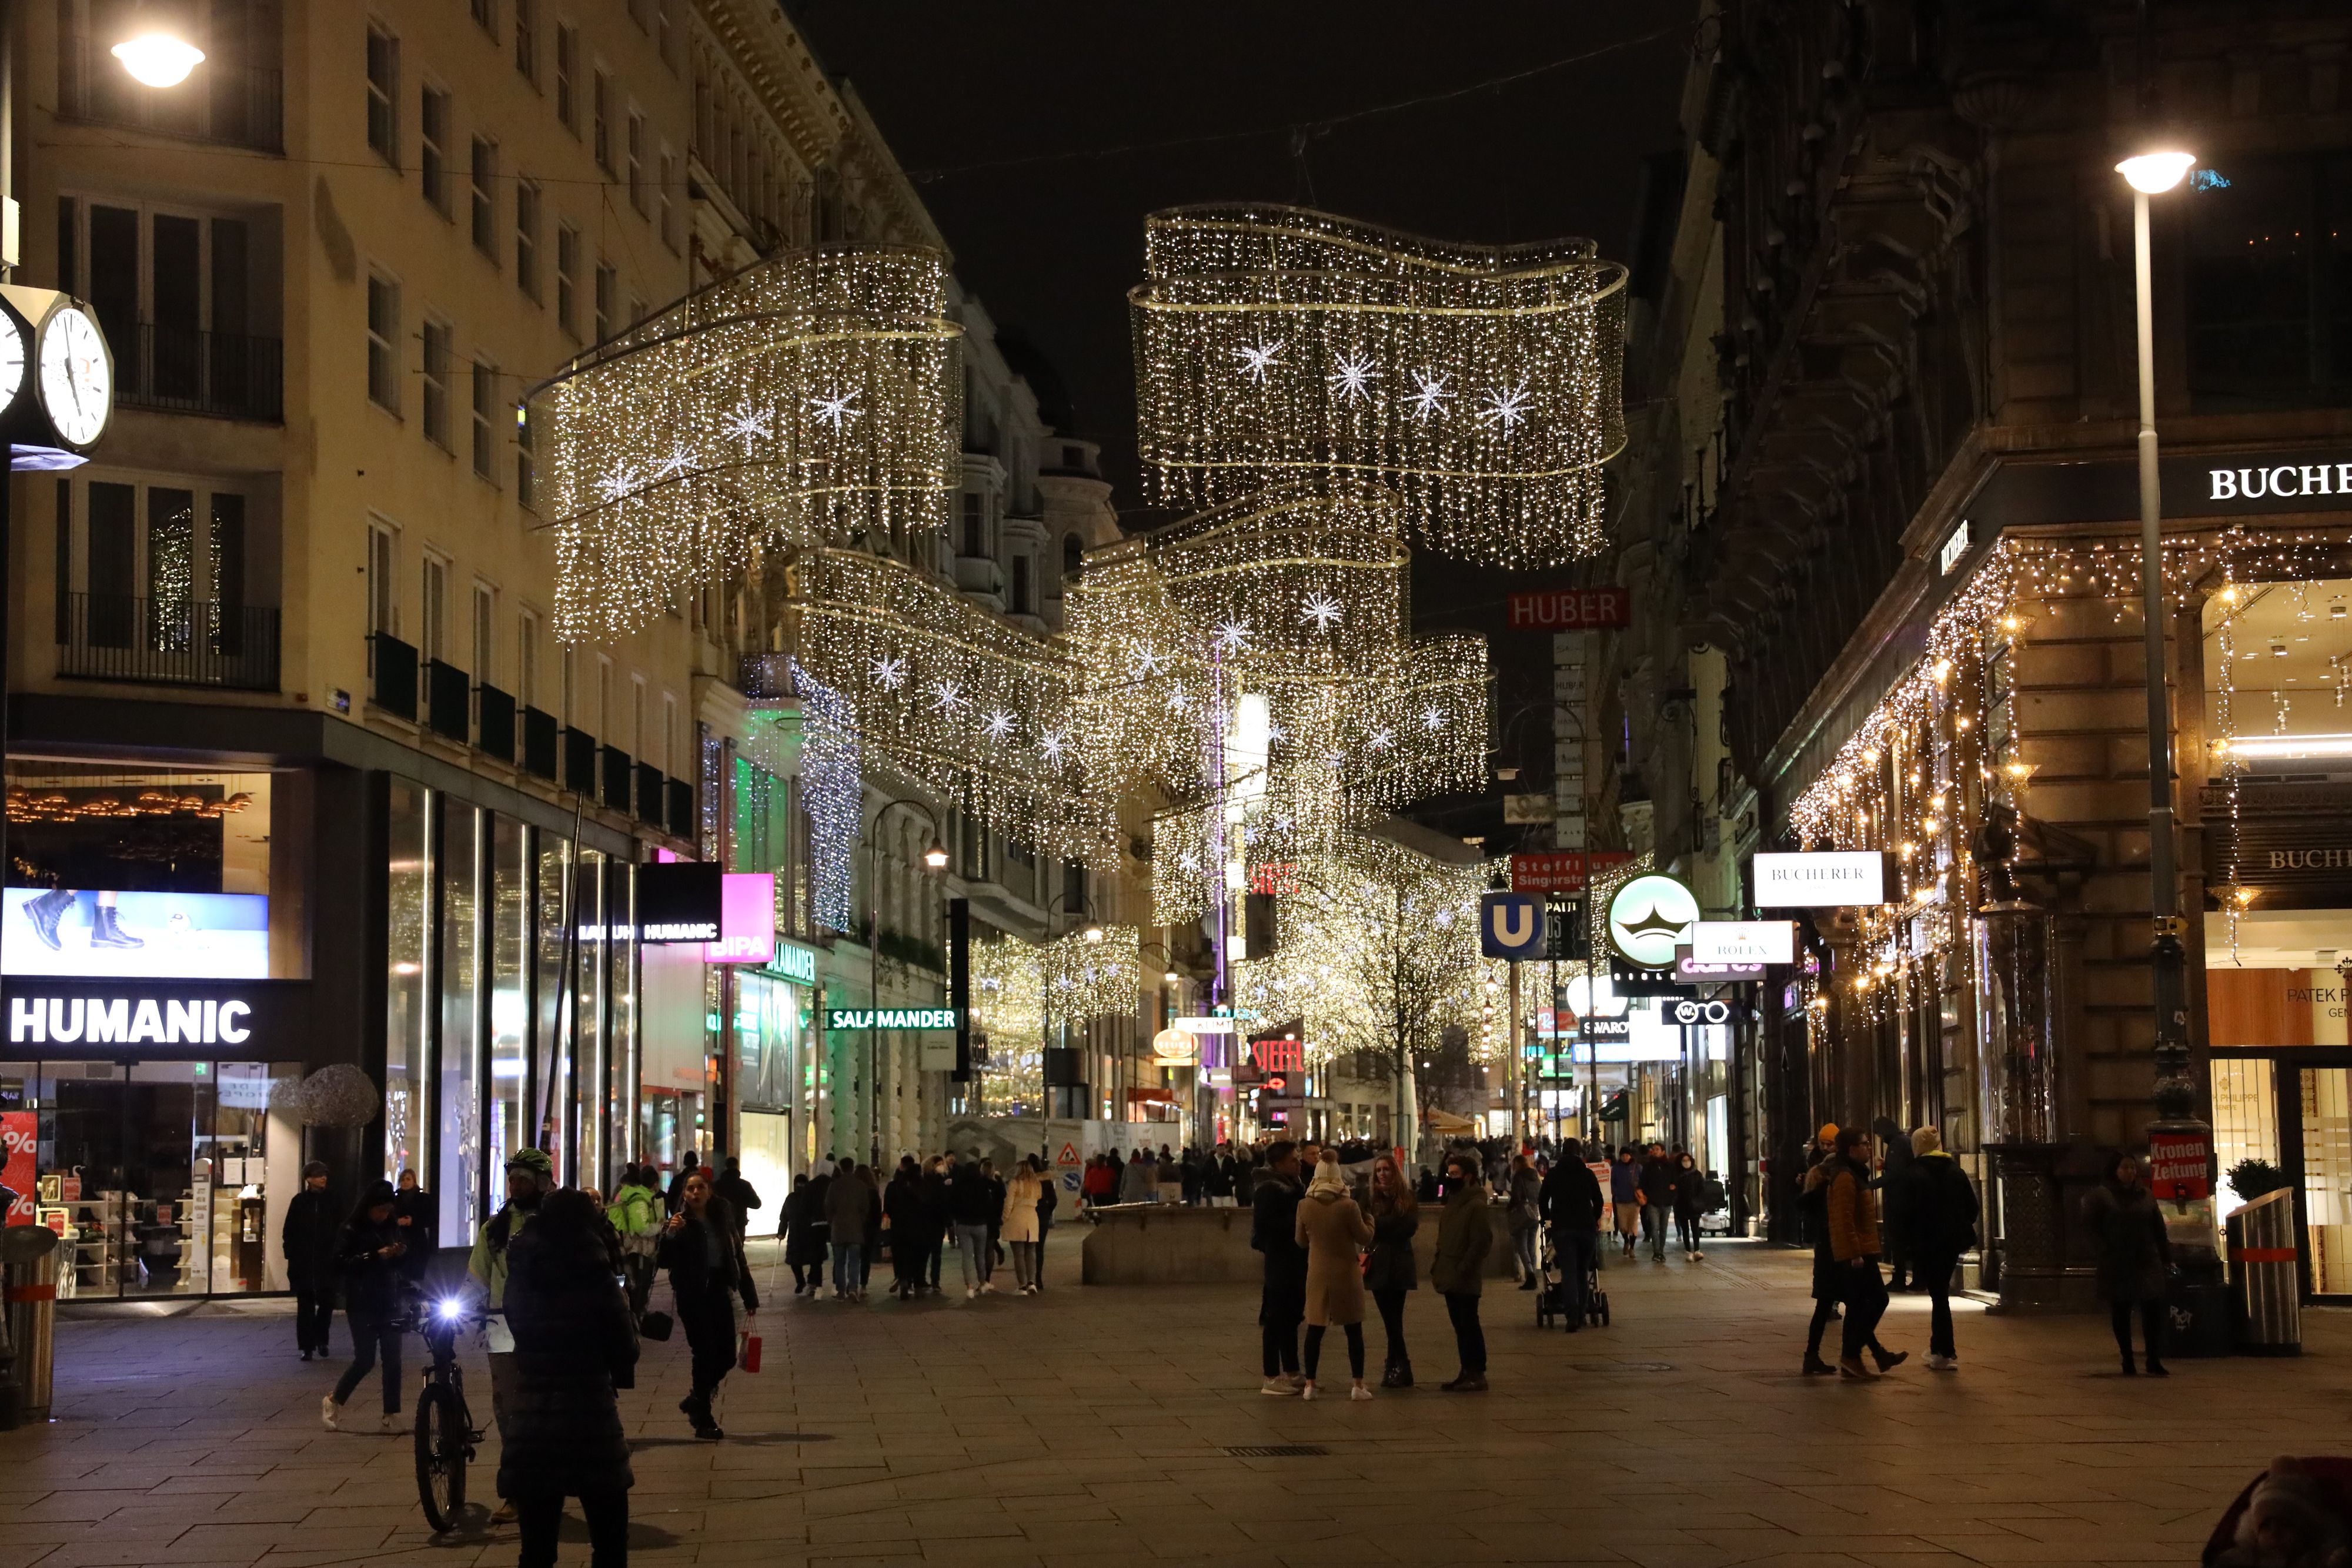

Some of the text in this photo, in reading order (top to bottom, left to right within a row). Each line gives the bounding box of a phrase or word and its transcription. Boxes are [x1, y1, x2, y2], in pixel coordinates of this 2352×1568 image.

[1514, 594, 1617, 624] HUBER
[1518, 860, 1580, 872] Steffl
[1772, 868, 1863, 880] BUCHERER
[644, 923, 717, 940] HUMANIC
[1494, 905, 1532, 947] U
[711, 935, 767, 957] BIPA
[1718, 945, 1768, 955] ROLEX
[2287, 988, 2336, 1002] PATEK
[11, 998, 252, 1044] HUMANIC
[833, 1010, 956, 1028] SALAMANDER
[1197, 1020, 1232, 1029] KLIMT
[1158, 1041, 1192, 1049] SLUKA
[1252, 1040, 1304, 1072] STEFFL
[2150, 1142, 2204, 1161] Kronen
[2152, 1162, 2207, 1180] Zeitung
